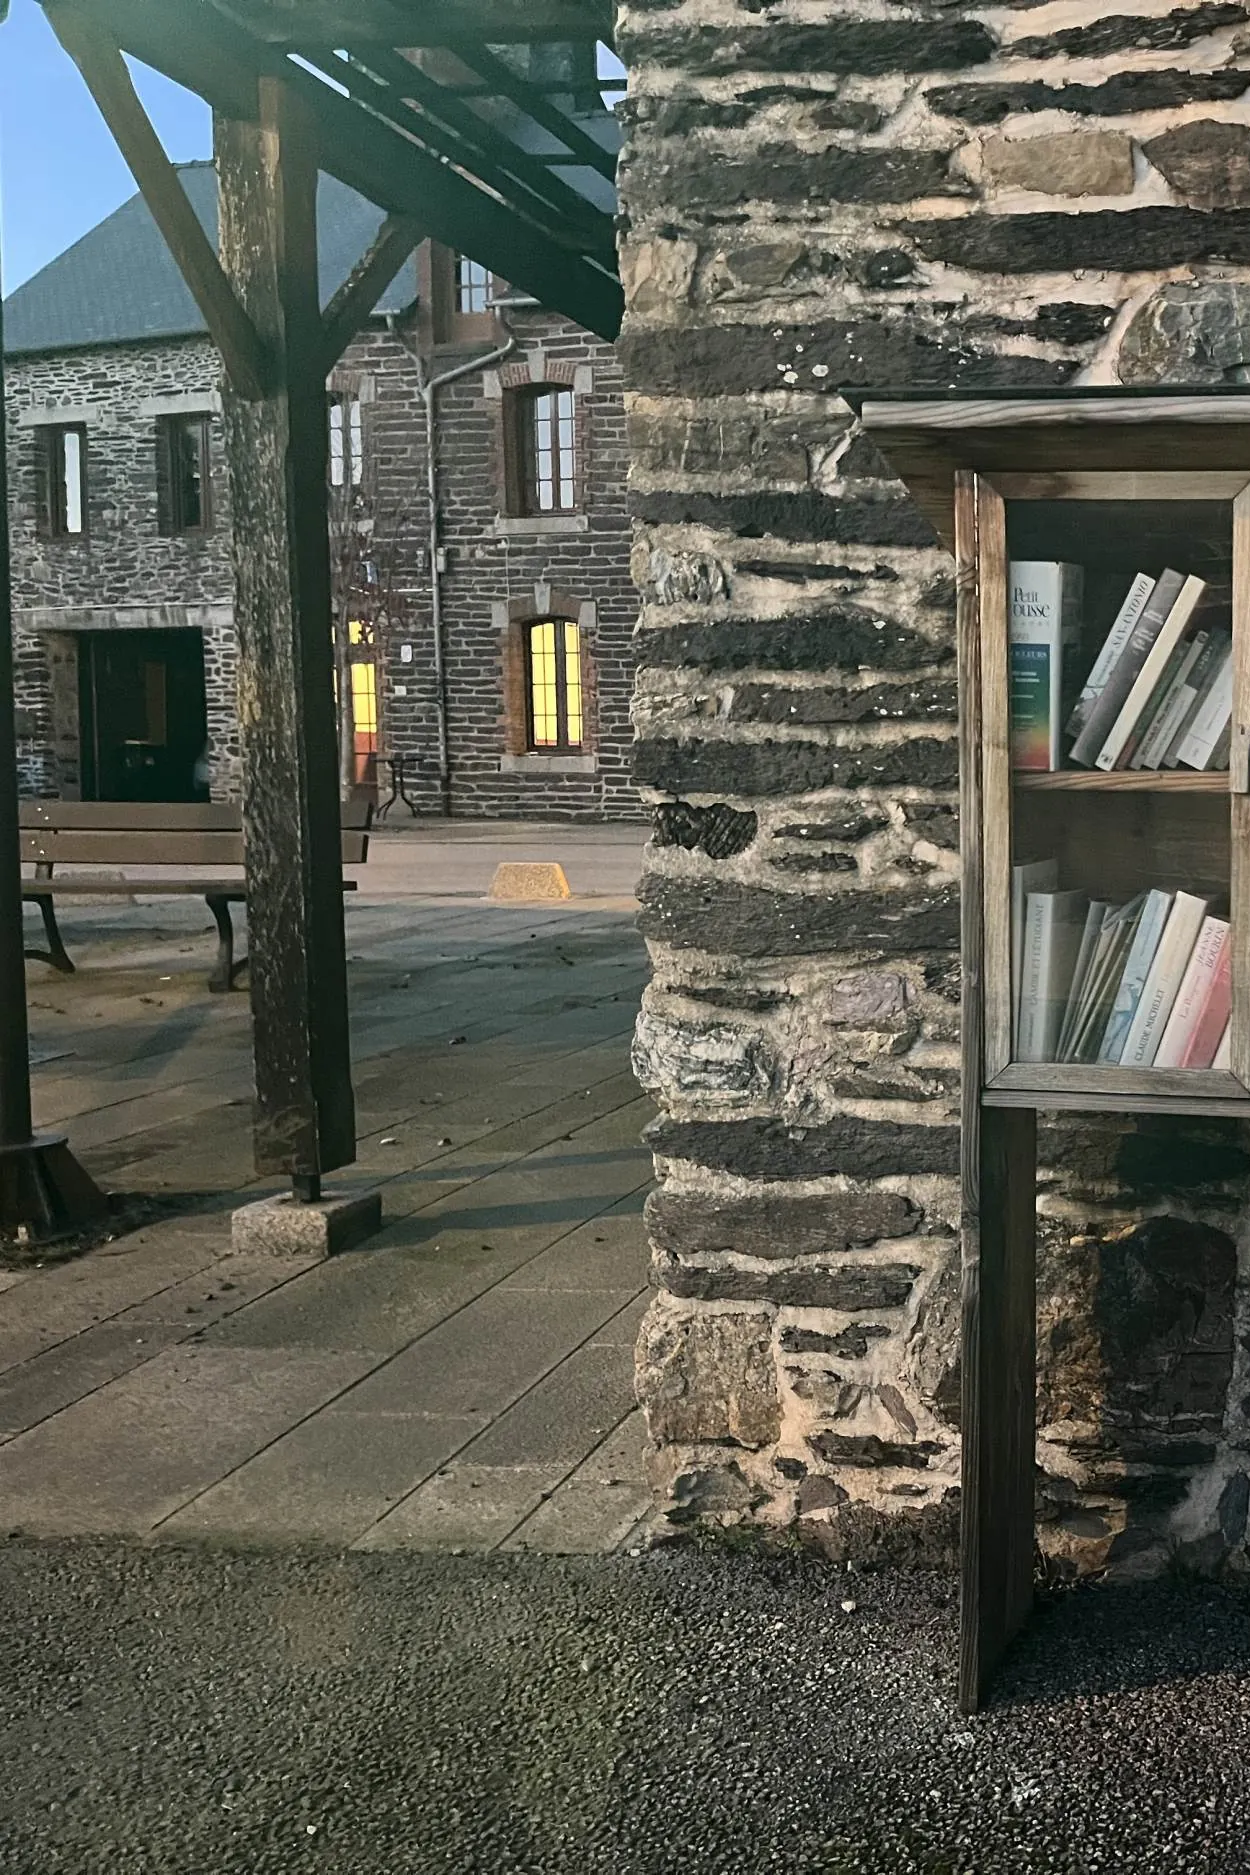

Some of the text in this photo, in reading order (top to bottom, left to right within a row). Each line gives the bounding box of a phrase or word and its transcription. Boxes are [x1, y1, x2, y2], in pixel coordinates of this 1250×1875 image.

[1014, 587, 1038, 603] Petit
[1111, 580, 1149, 650] SAN-ANTONIO
[1204, 927, 1226, 967] BOURIN
[1135, 989, 1166, 1061] CLAUDE MICHELET
